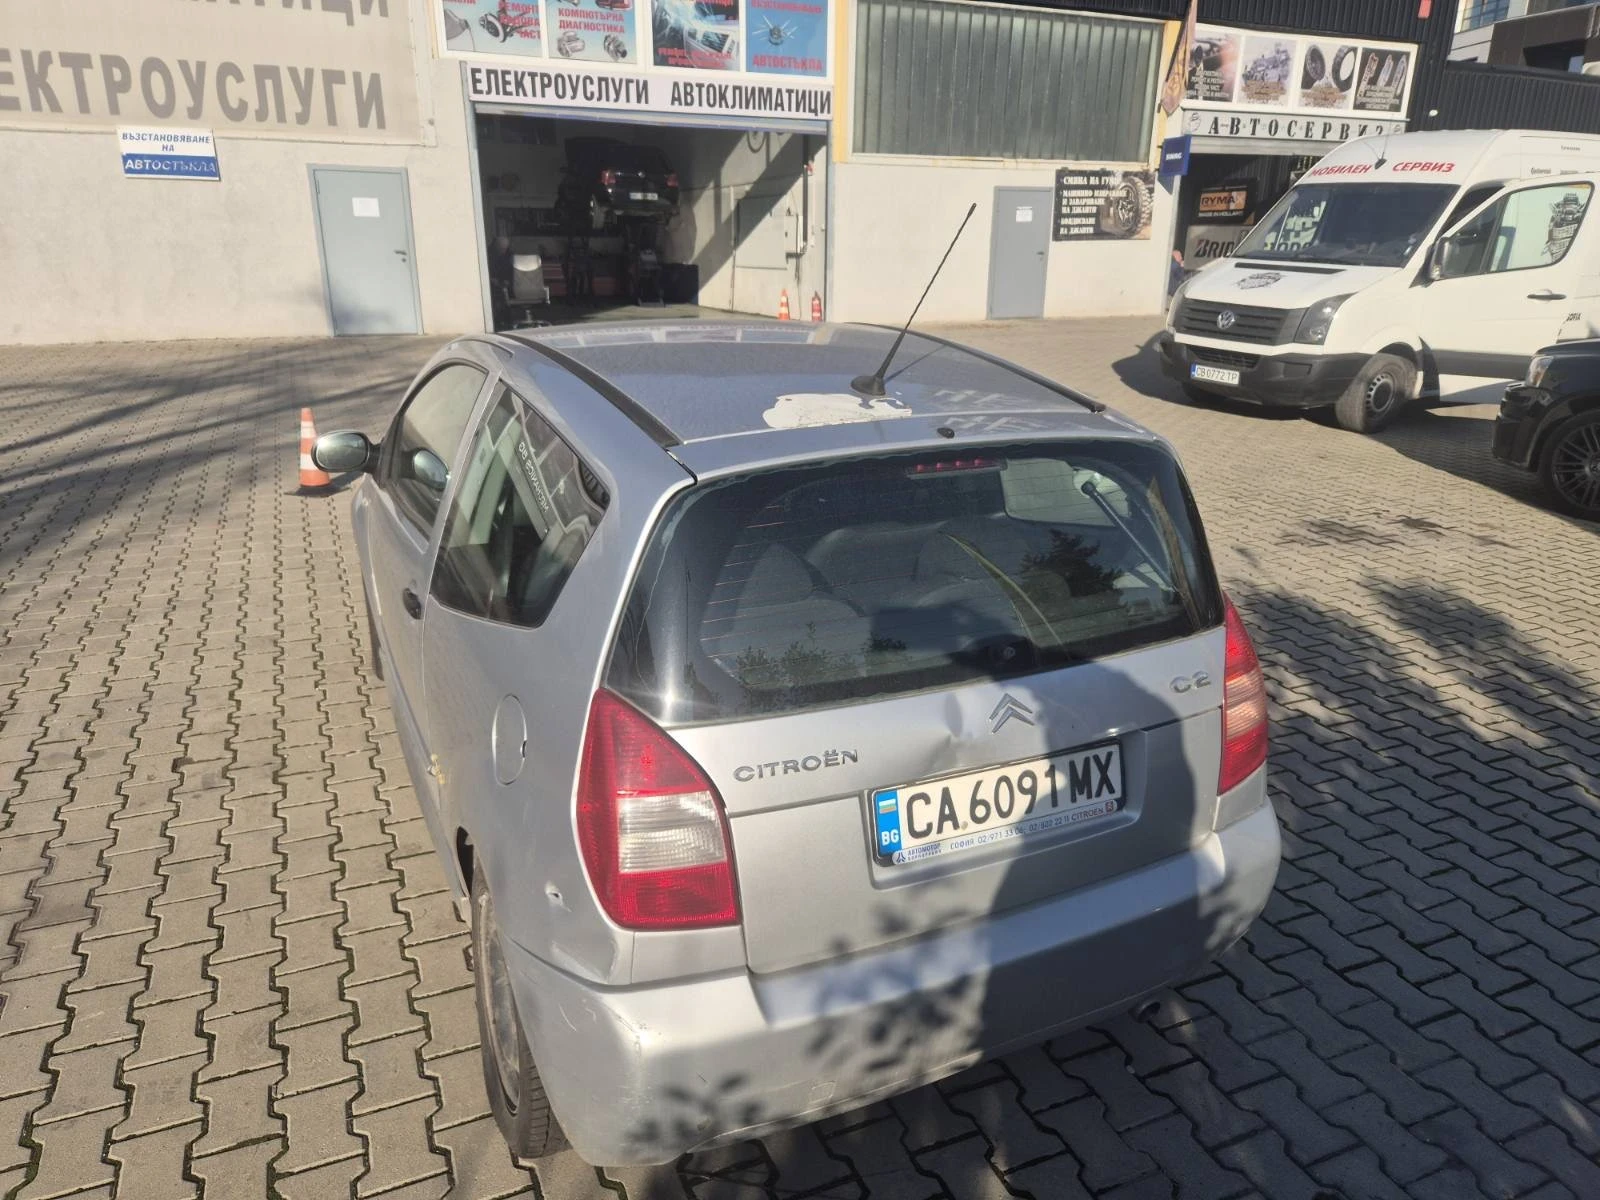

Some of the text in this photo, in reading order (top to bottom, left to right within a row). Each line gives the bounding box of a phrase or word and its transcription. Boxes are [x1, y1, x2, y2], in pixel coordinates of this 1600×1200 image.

[558, 8, 624, 22] КОМПЮТЪРНА
[559, 20, 625, 33] ДИАГНОСТИКА
[470, 67, 831, 116] ЕЛЕКТРОУСЛУГИ АВТОКЛИМАТИЦИ
[122, 132, 210, 144] ВЪЗСТАНОВЯВАНЕ
[161, 143, 175, 152] НА
[125, 159, 216, 172] АВТОСТЪКЛА
[1392, 162, 1456, 173] СЕРВИЗ
[733, 748, 859, 783] CITROËN
[906, 750, 1116, 840] CA 6091 MX
[880, 828, 900, 847] BG
